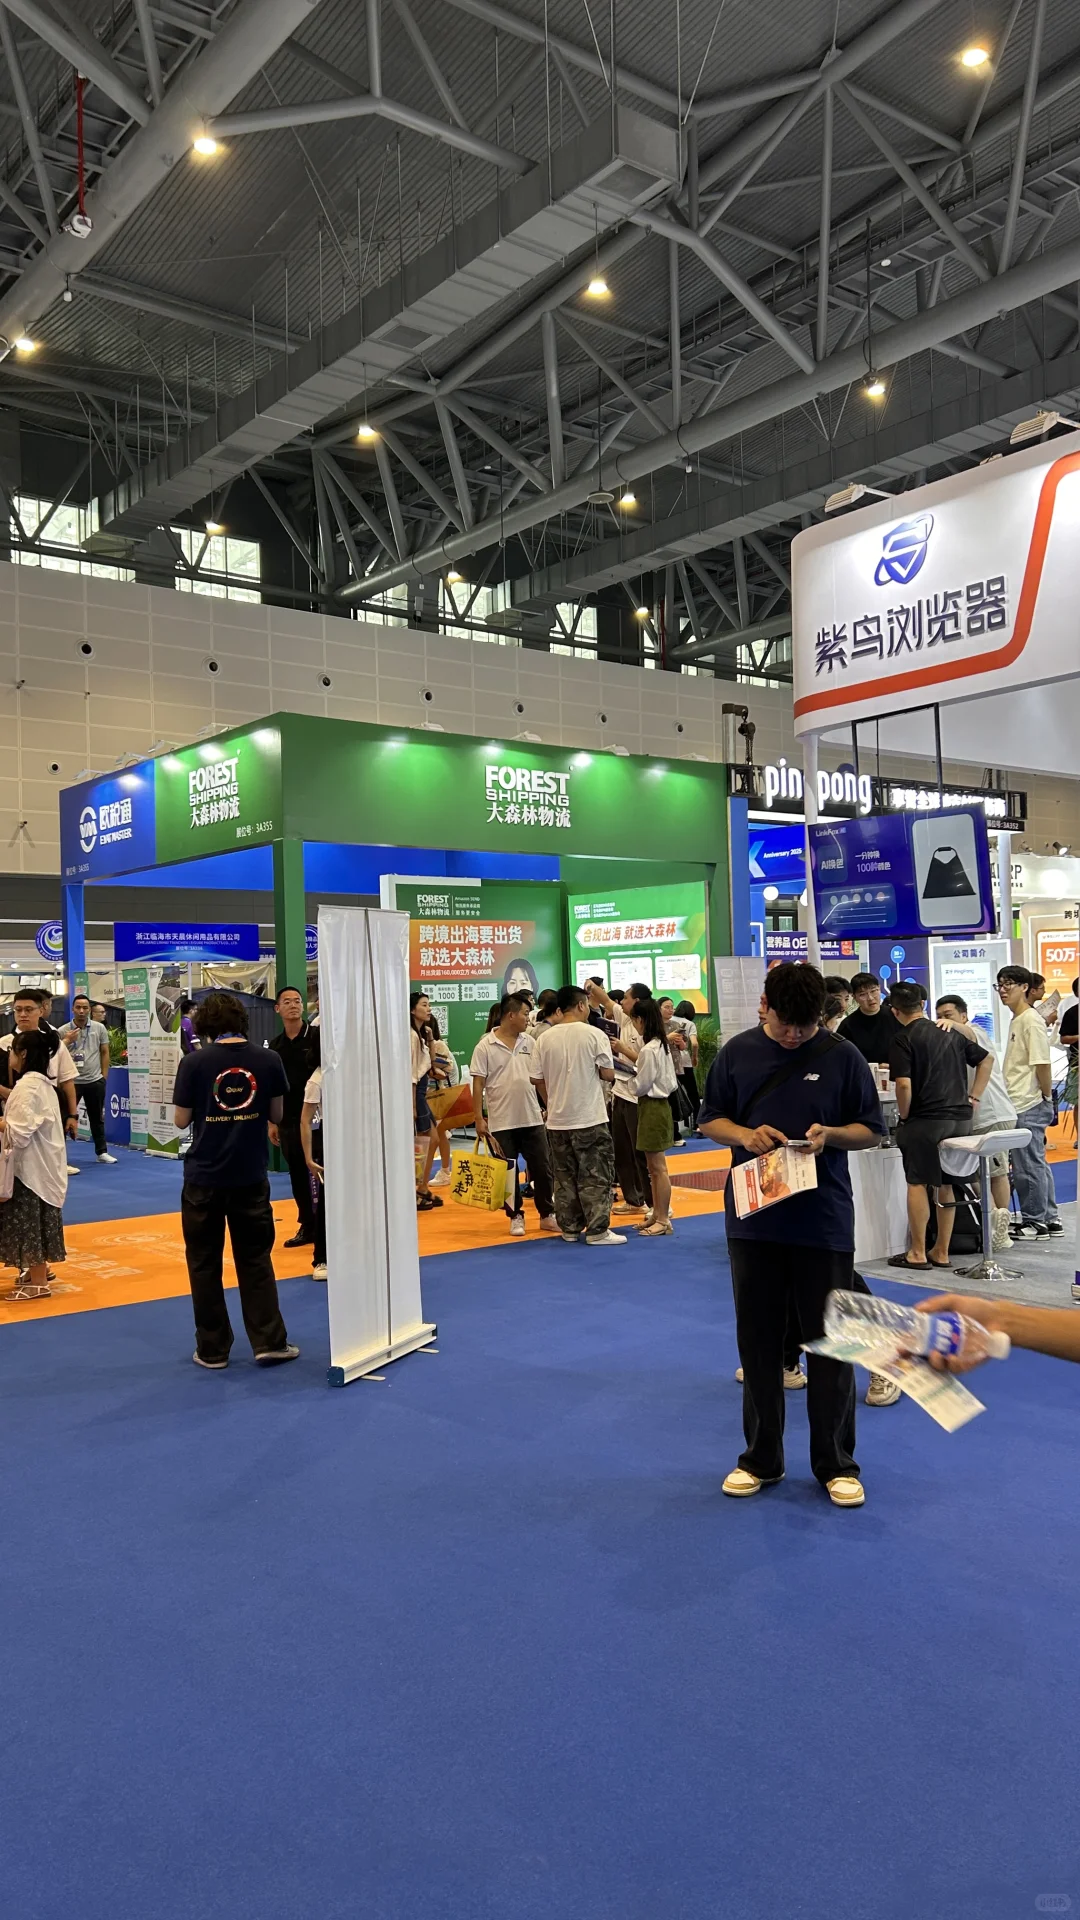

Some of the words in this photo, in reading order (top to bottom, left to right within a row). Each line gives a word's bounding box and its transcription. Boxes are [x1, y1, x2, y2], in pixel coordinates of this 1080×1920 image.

[815, 575, 1007, 675] 紫鸟浏览器
[189, 757, 239, 794] FOREST
[485, 764, 571, 795] FOREST
[765, 758, 872, 814] pinpong
[189, 781, 239, 807] SHIPPING
[485, 788, 570, 807] SHIPPING
[99, 797, 132, 831] 欧税通
[190, 795, 240, 829] 大森林物流
[486, 802, 571, 828] 大森林物流
[763, 850, 790, 859] Anniversary
[417, 894, 449, 904] FOREST
[418, 907, 450, 916] 大森林物流
[419, 924, 522, 945] 跨境出海要出货
[583, 926, 622, 943] 合规出海
[624, 921, 676, 940] 就选大森林
[420, 947, 495, 967] 就选大森林
[953, 948, 986, 959] 公司简介
